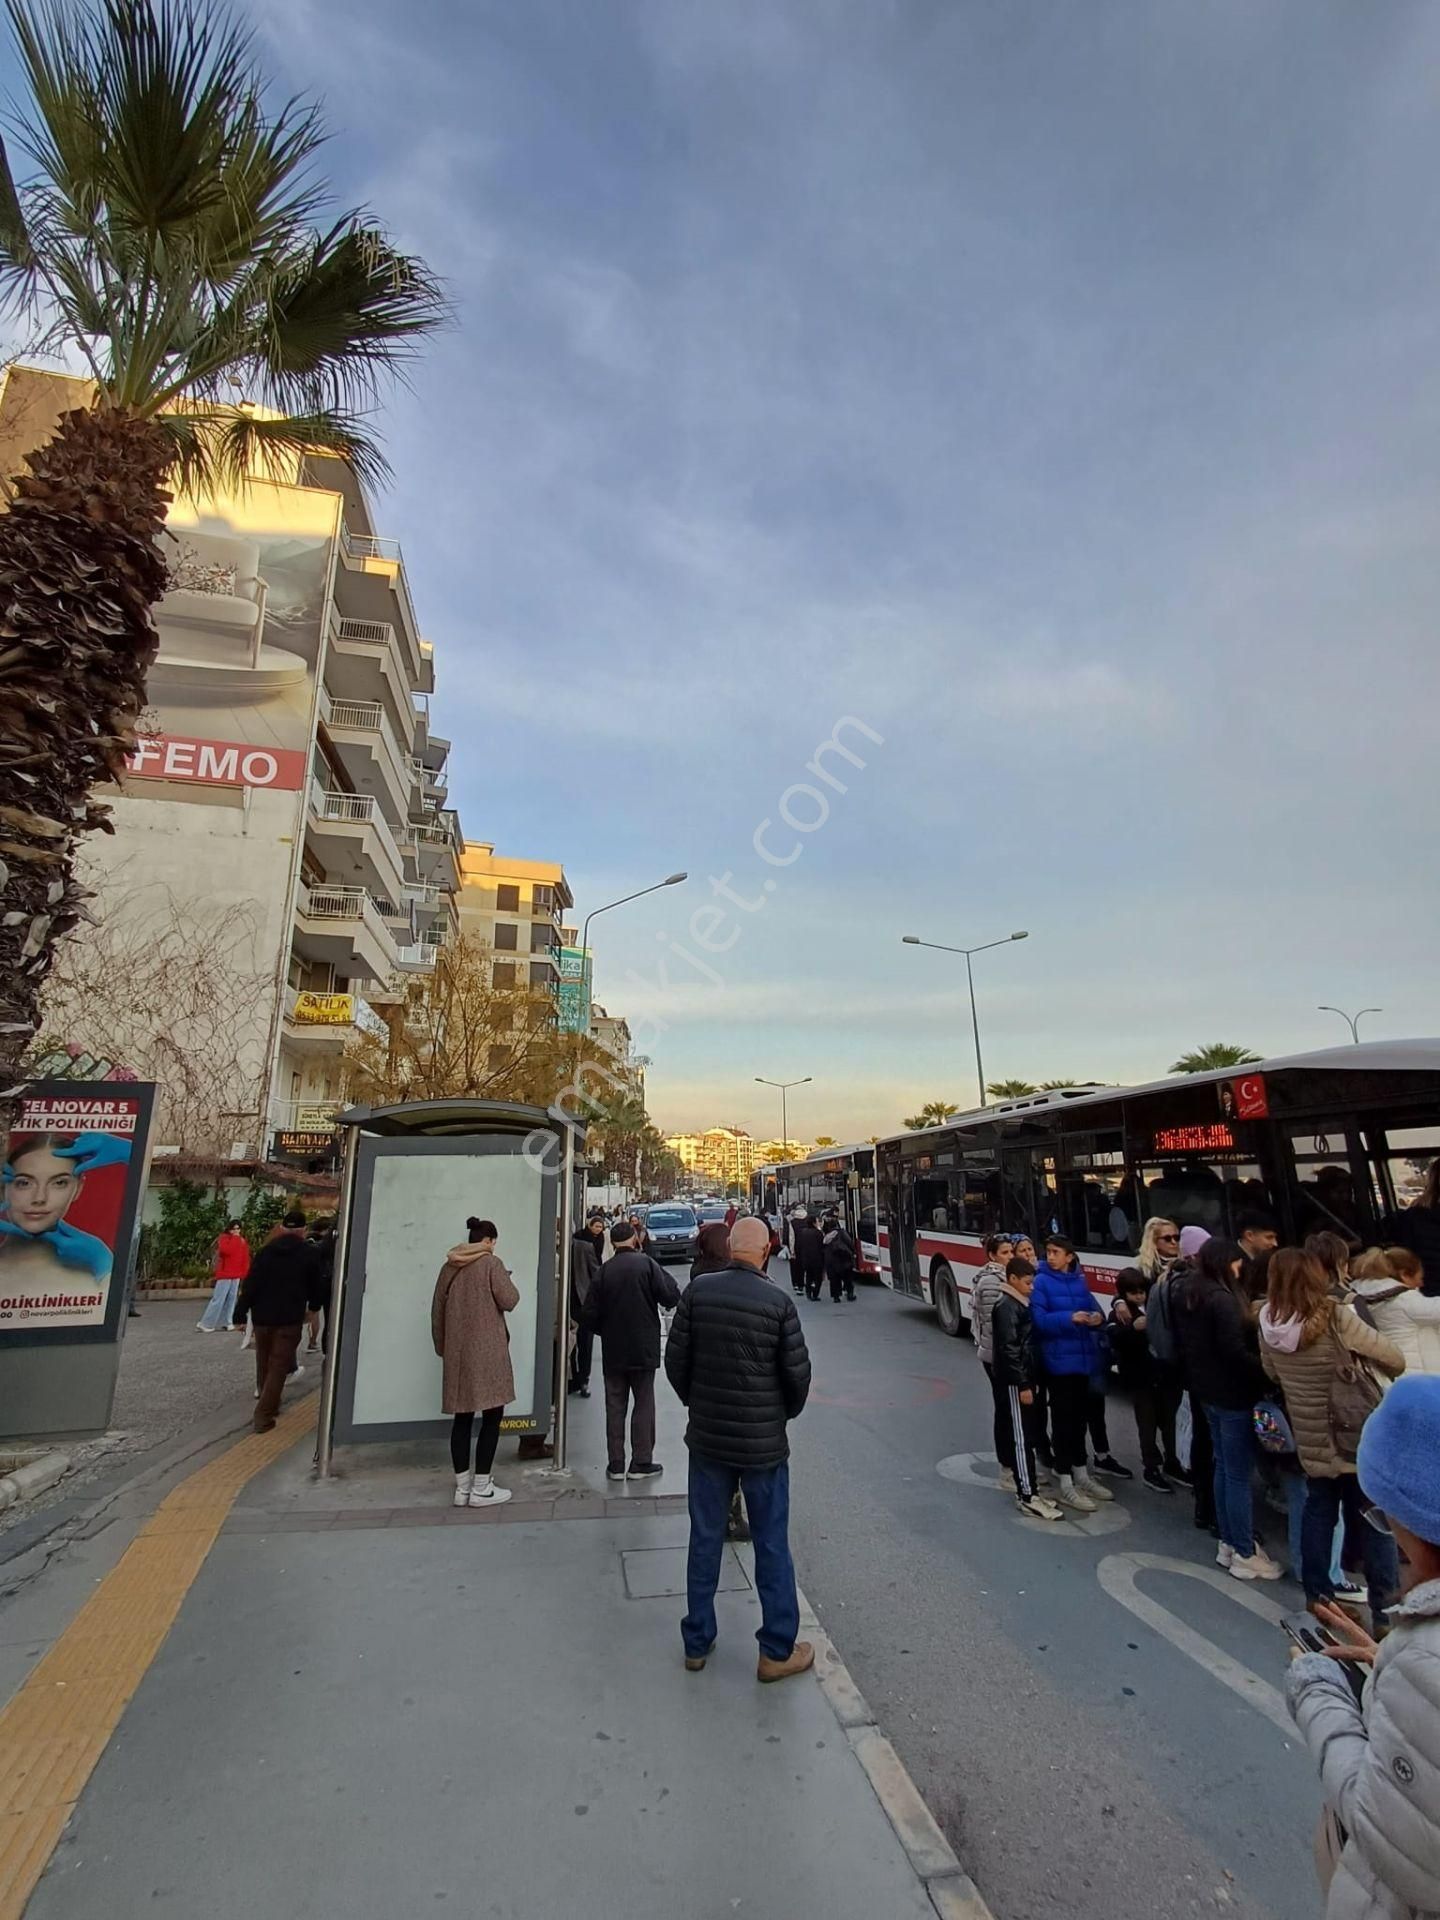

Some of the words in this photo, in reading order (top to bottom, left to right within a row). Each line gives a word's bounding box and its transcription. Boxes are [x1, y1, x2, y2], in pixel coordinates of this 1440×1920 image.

[126, 738, 278, 784] FEMO
[23, 1100, 48, 1113] ZEL
[51, 1101, 114, 1113] NOVAR
[119, 1102, 128, 1113] 5
[13, 1115, 41, 1129] TİK
[45, 1115, 134, 1129] POLİKLİNİĞİ
